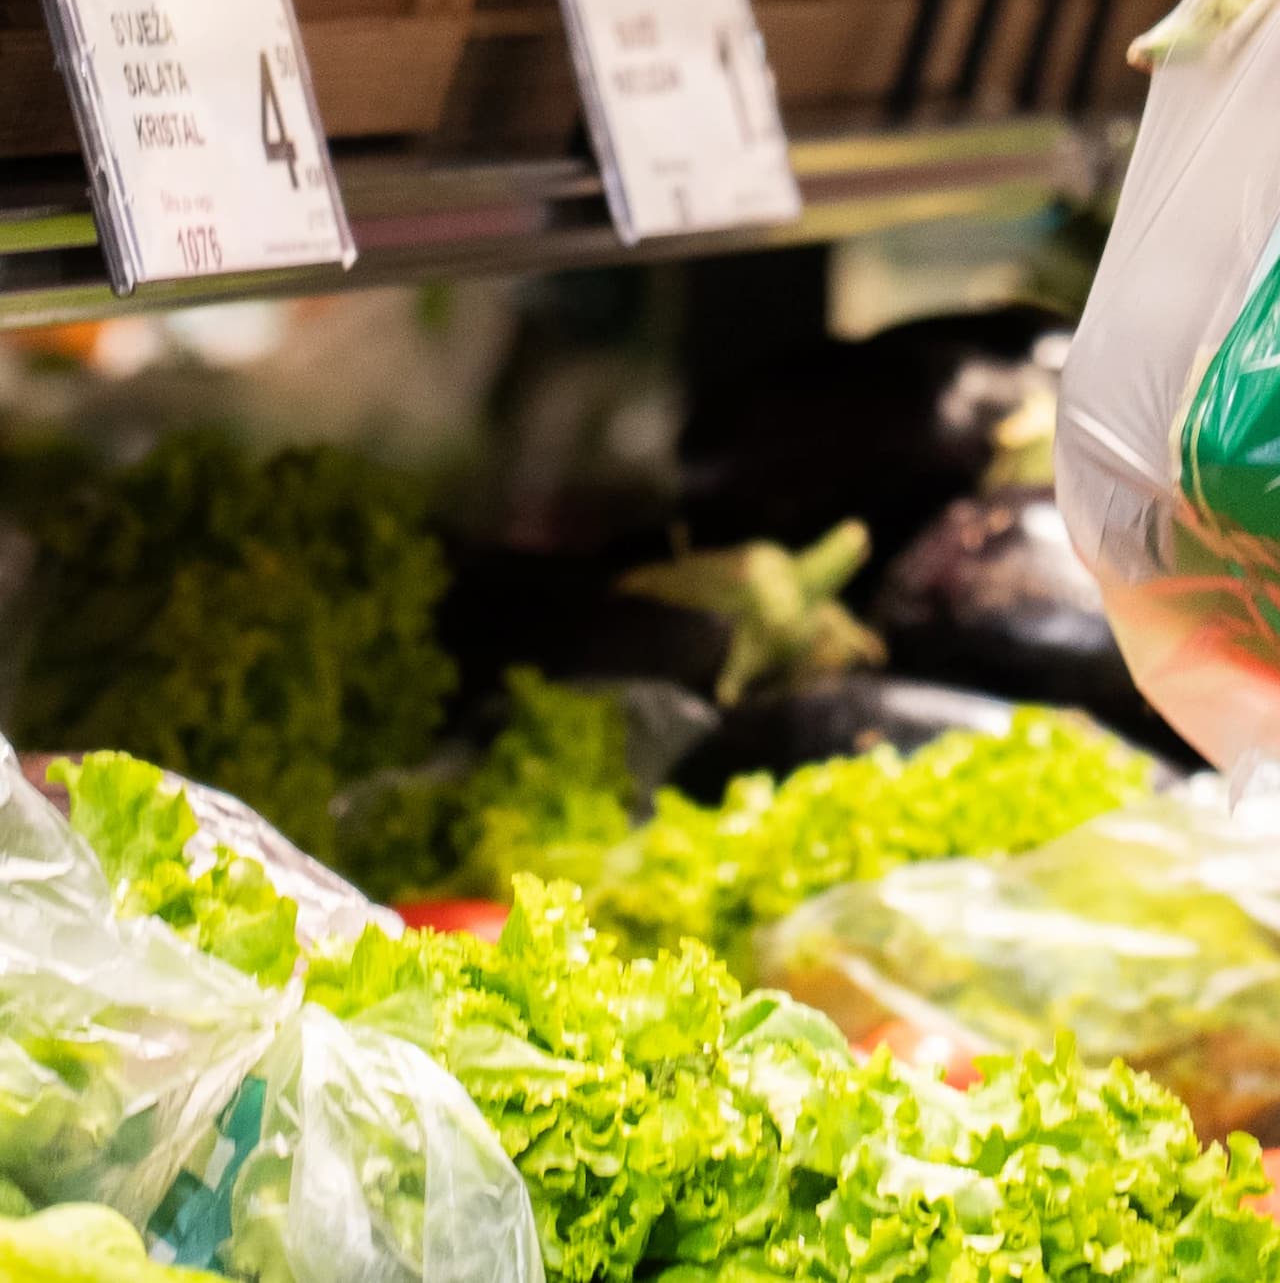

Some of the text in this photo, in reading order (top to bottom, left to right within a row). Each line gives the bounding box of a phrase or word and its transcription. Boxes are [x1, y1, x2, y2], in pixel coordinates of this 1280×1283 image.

[123, 61, 192, 98] SALATA
[133, 112, 206, 150] KRISTAL
[259, 48, 299, 191] 4
